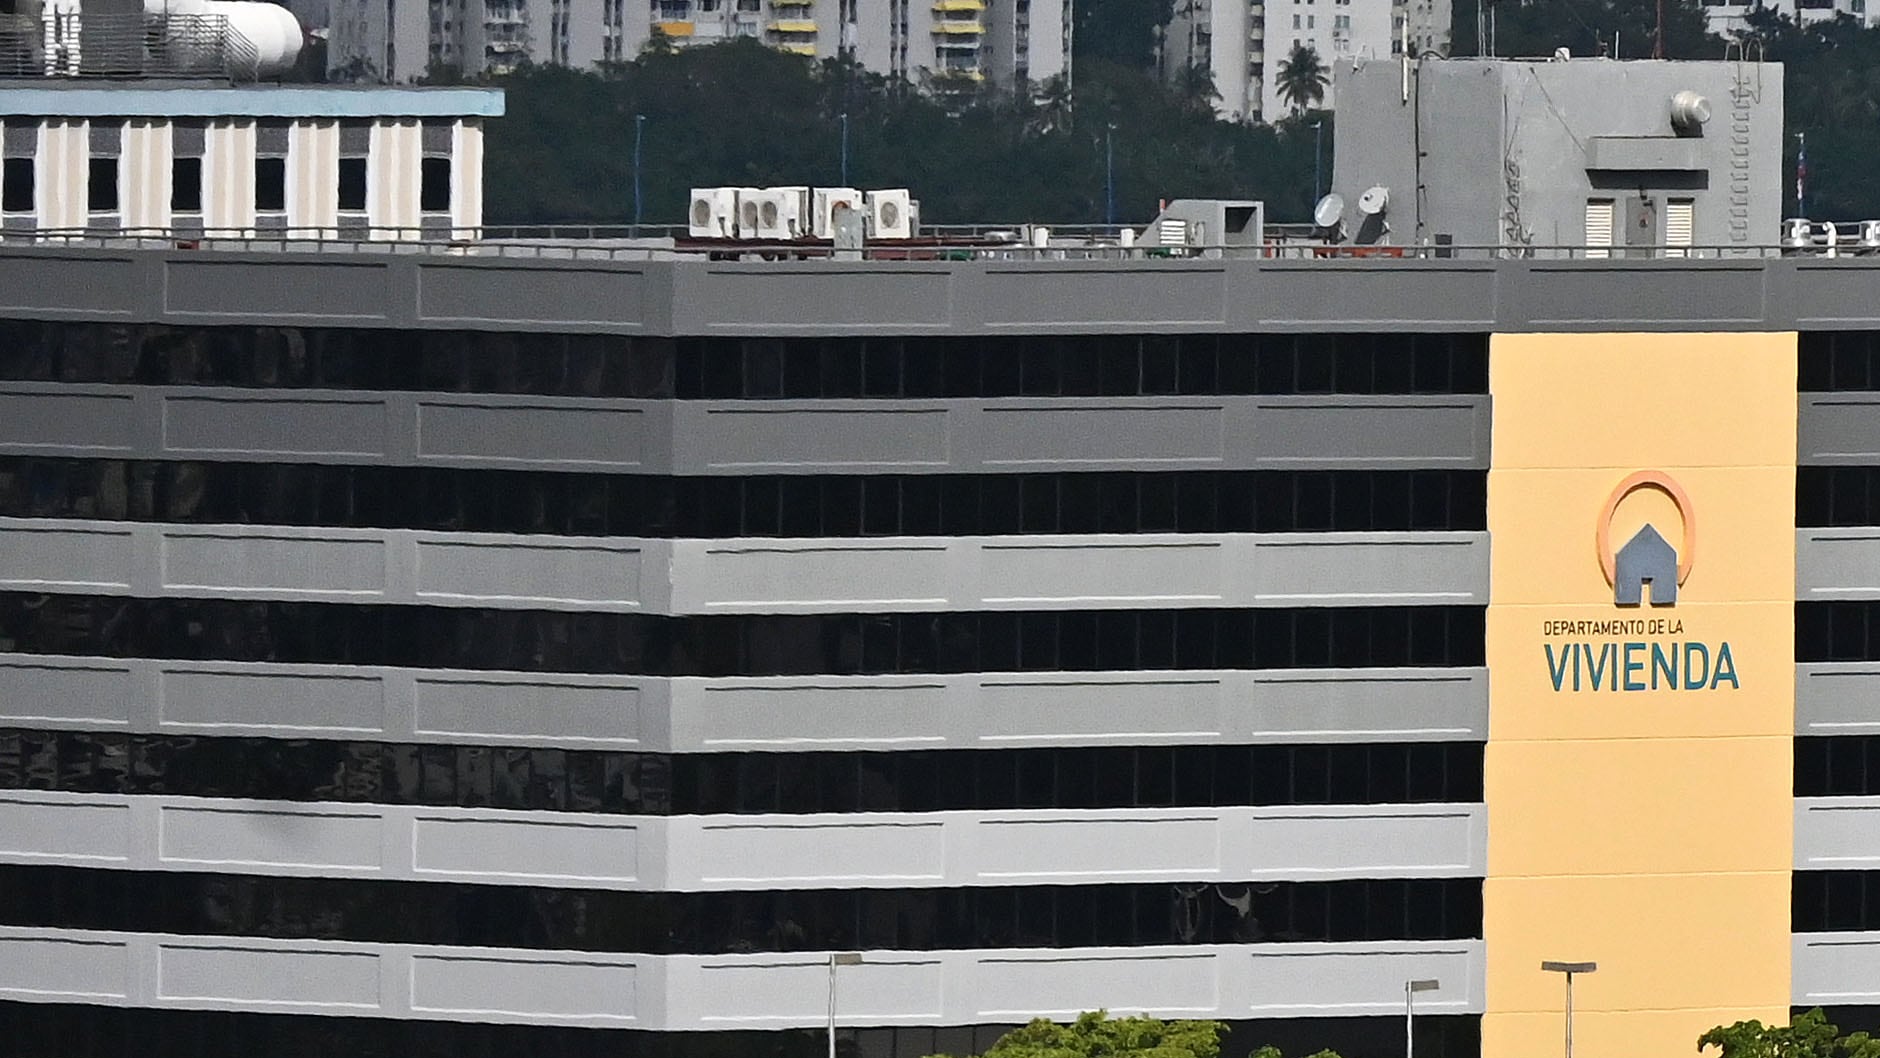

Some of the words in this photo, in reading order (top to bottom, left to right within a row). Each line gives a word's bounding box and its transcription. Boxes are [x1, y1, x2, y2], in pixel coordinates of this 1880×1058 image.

[1544, 620, 1645, 635] DEPARTAMENTO
[1649, 619, 1665, 634] DE
[1668, 619, 1684, 634] LA
[1544, 642, 1739, 691] VIVIENDA
